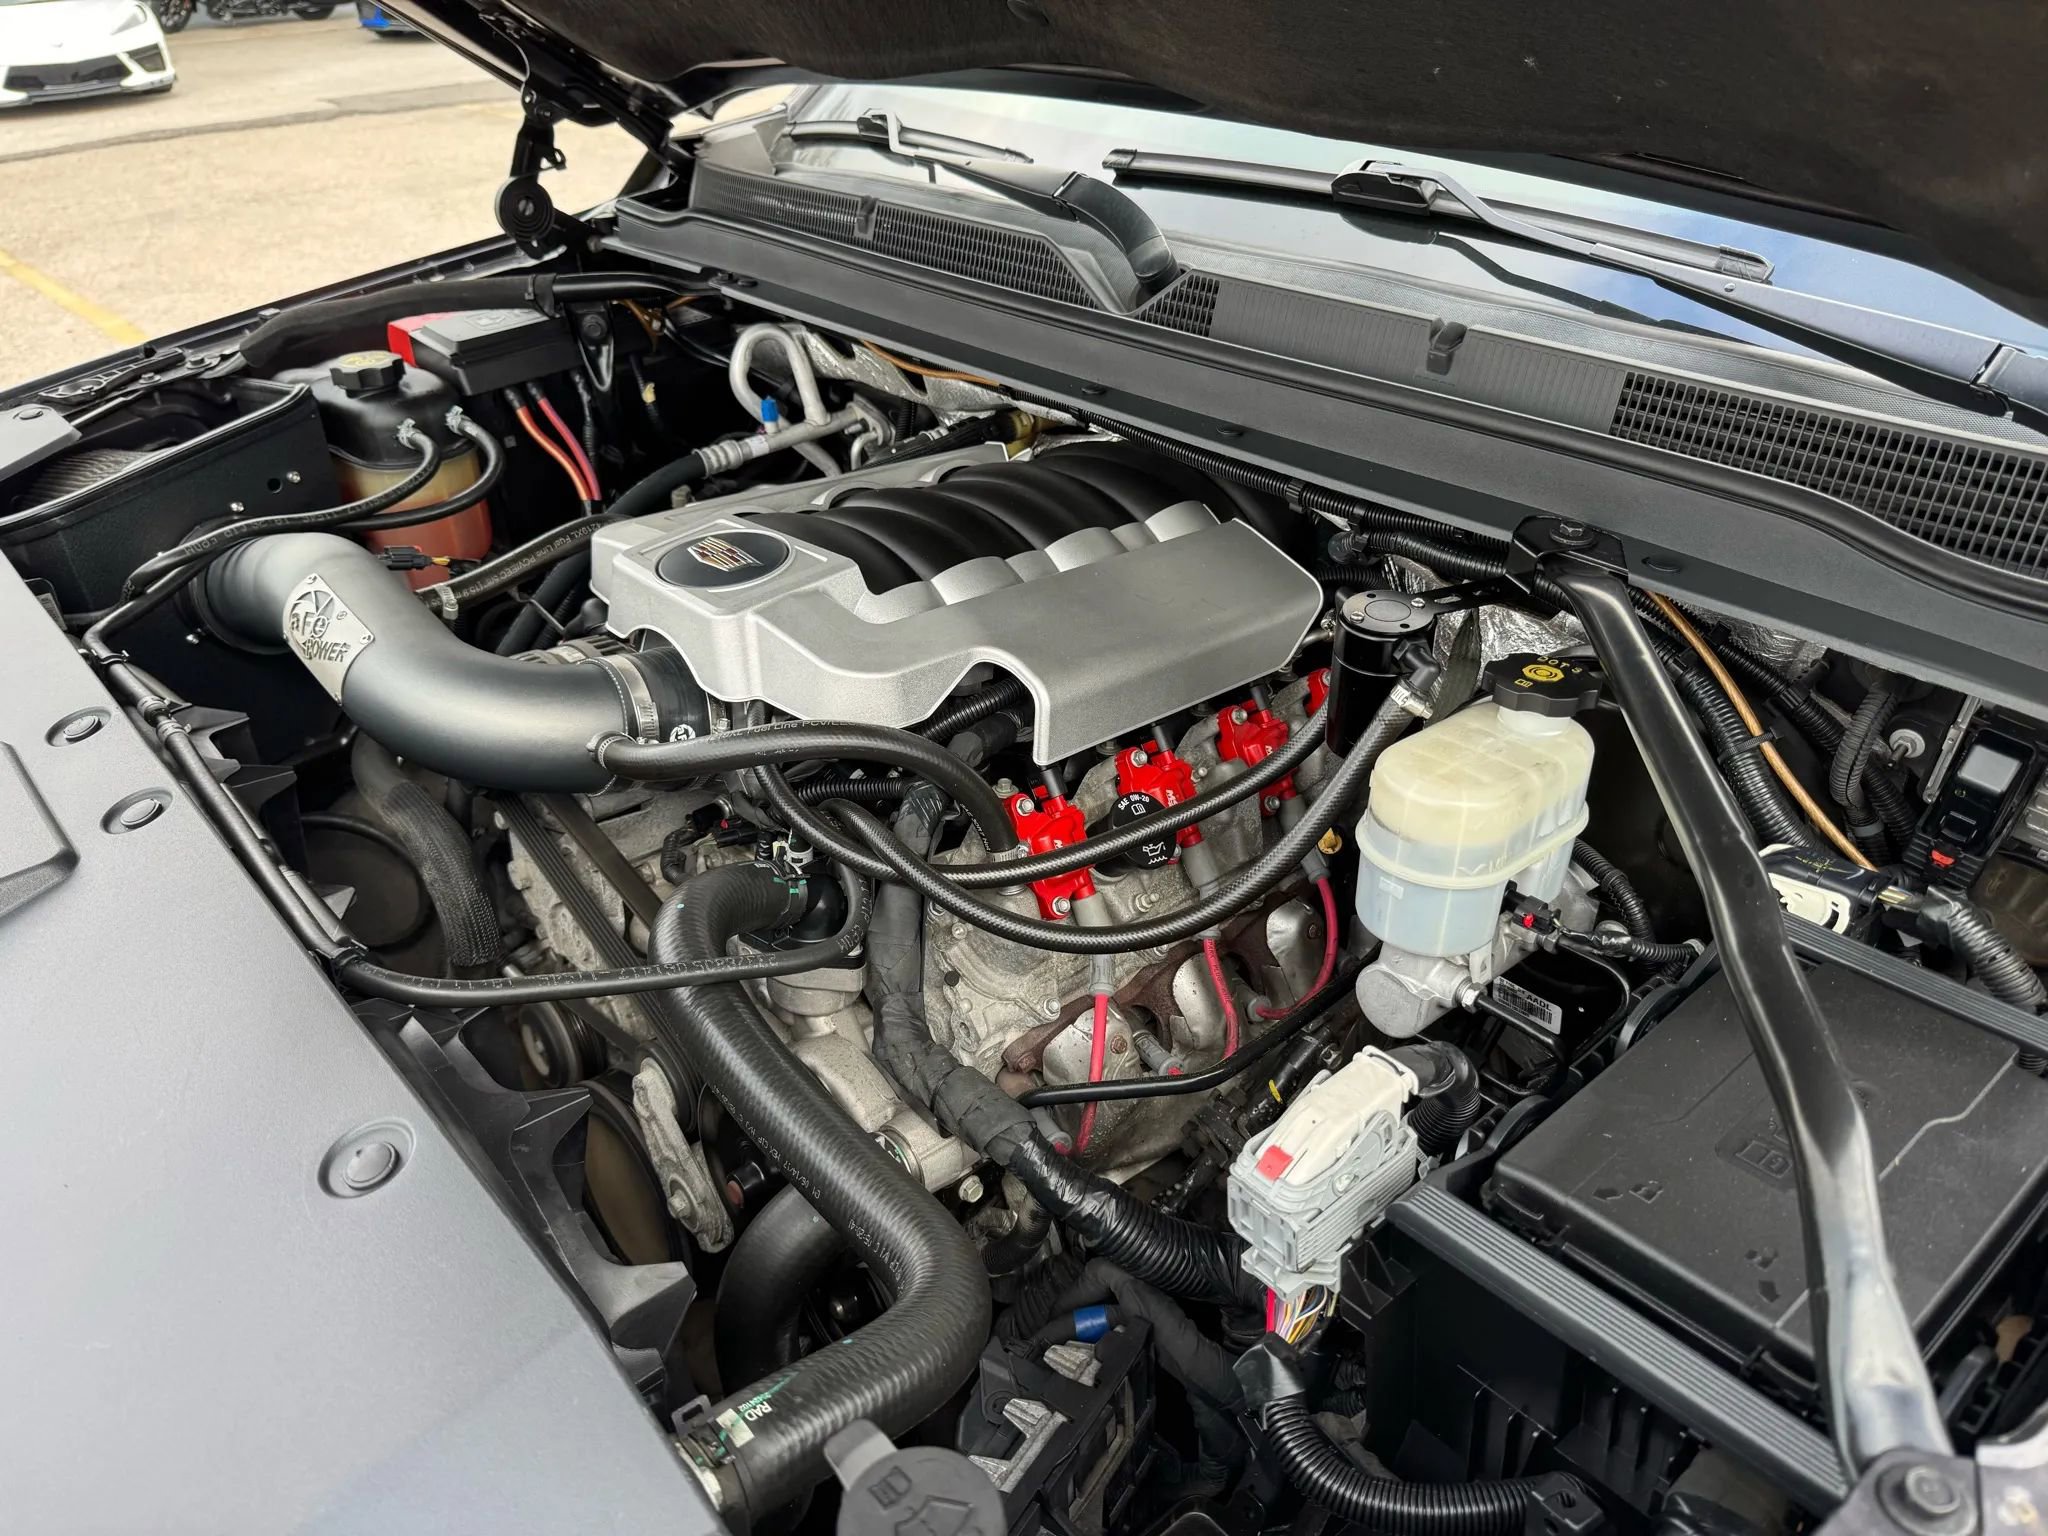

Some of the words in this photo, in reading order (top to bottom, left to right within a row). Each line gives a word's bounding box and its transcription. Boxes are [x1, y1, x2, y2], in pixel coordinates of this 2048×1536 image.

[553, 537, 571, 548] Fuel
[536, 546, 554, 556] Line
[303, 638, 352, 663] POWER
[1537, 656, 1570, 668] DOT
[774, 722, 797, 731] Line
[1118, 798, 1130, 810] SAE
[1526, 994, 1552, 1011] AADL
[745, 1401, 773, 1421] RAD
